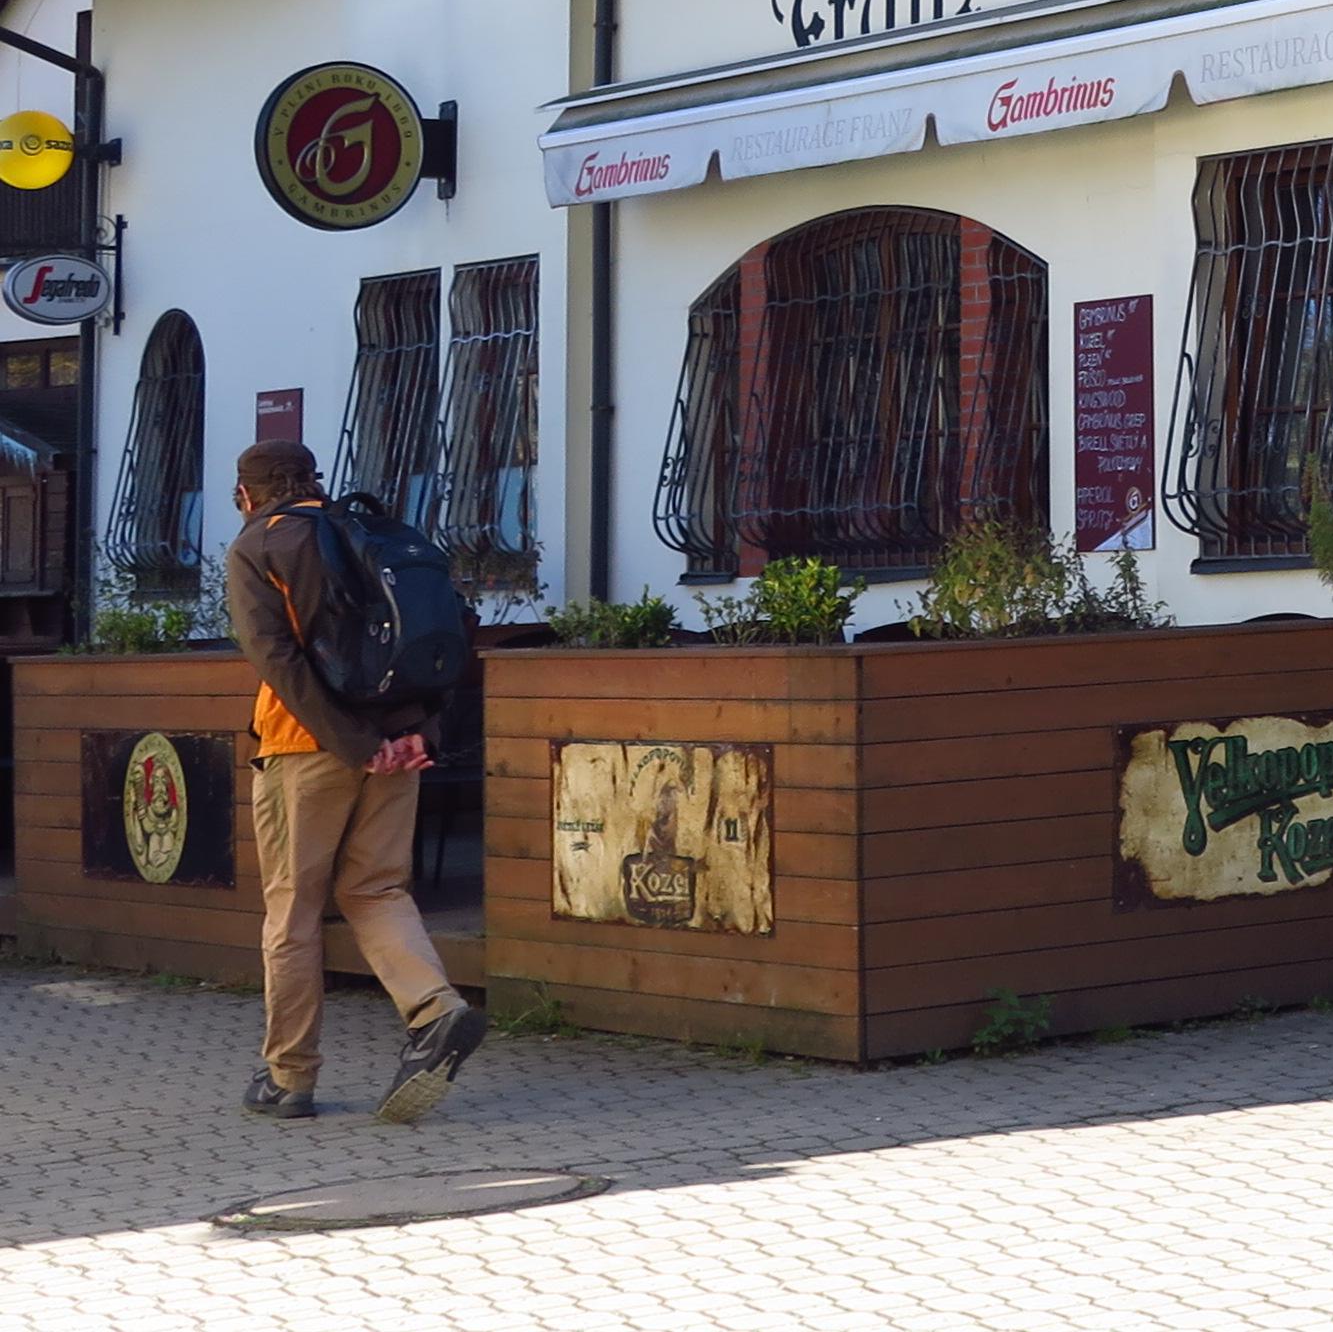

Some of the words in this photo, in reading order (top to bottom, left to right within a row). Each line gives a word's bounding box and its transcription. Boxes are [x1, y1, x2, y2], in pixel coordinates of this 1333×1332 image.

[987, 73, 1116, 133] Gambrinus
[731, 118, 847, 162] RESTAURACE
[848, 107, 913, 149] FRANZ
[575, 149, 671, 198] Gambrinus
[23, 266, 100, 304] Segafredo
